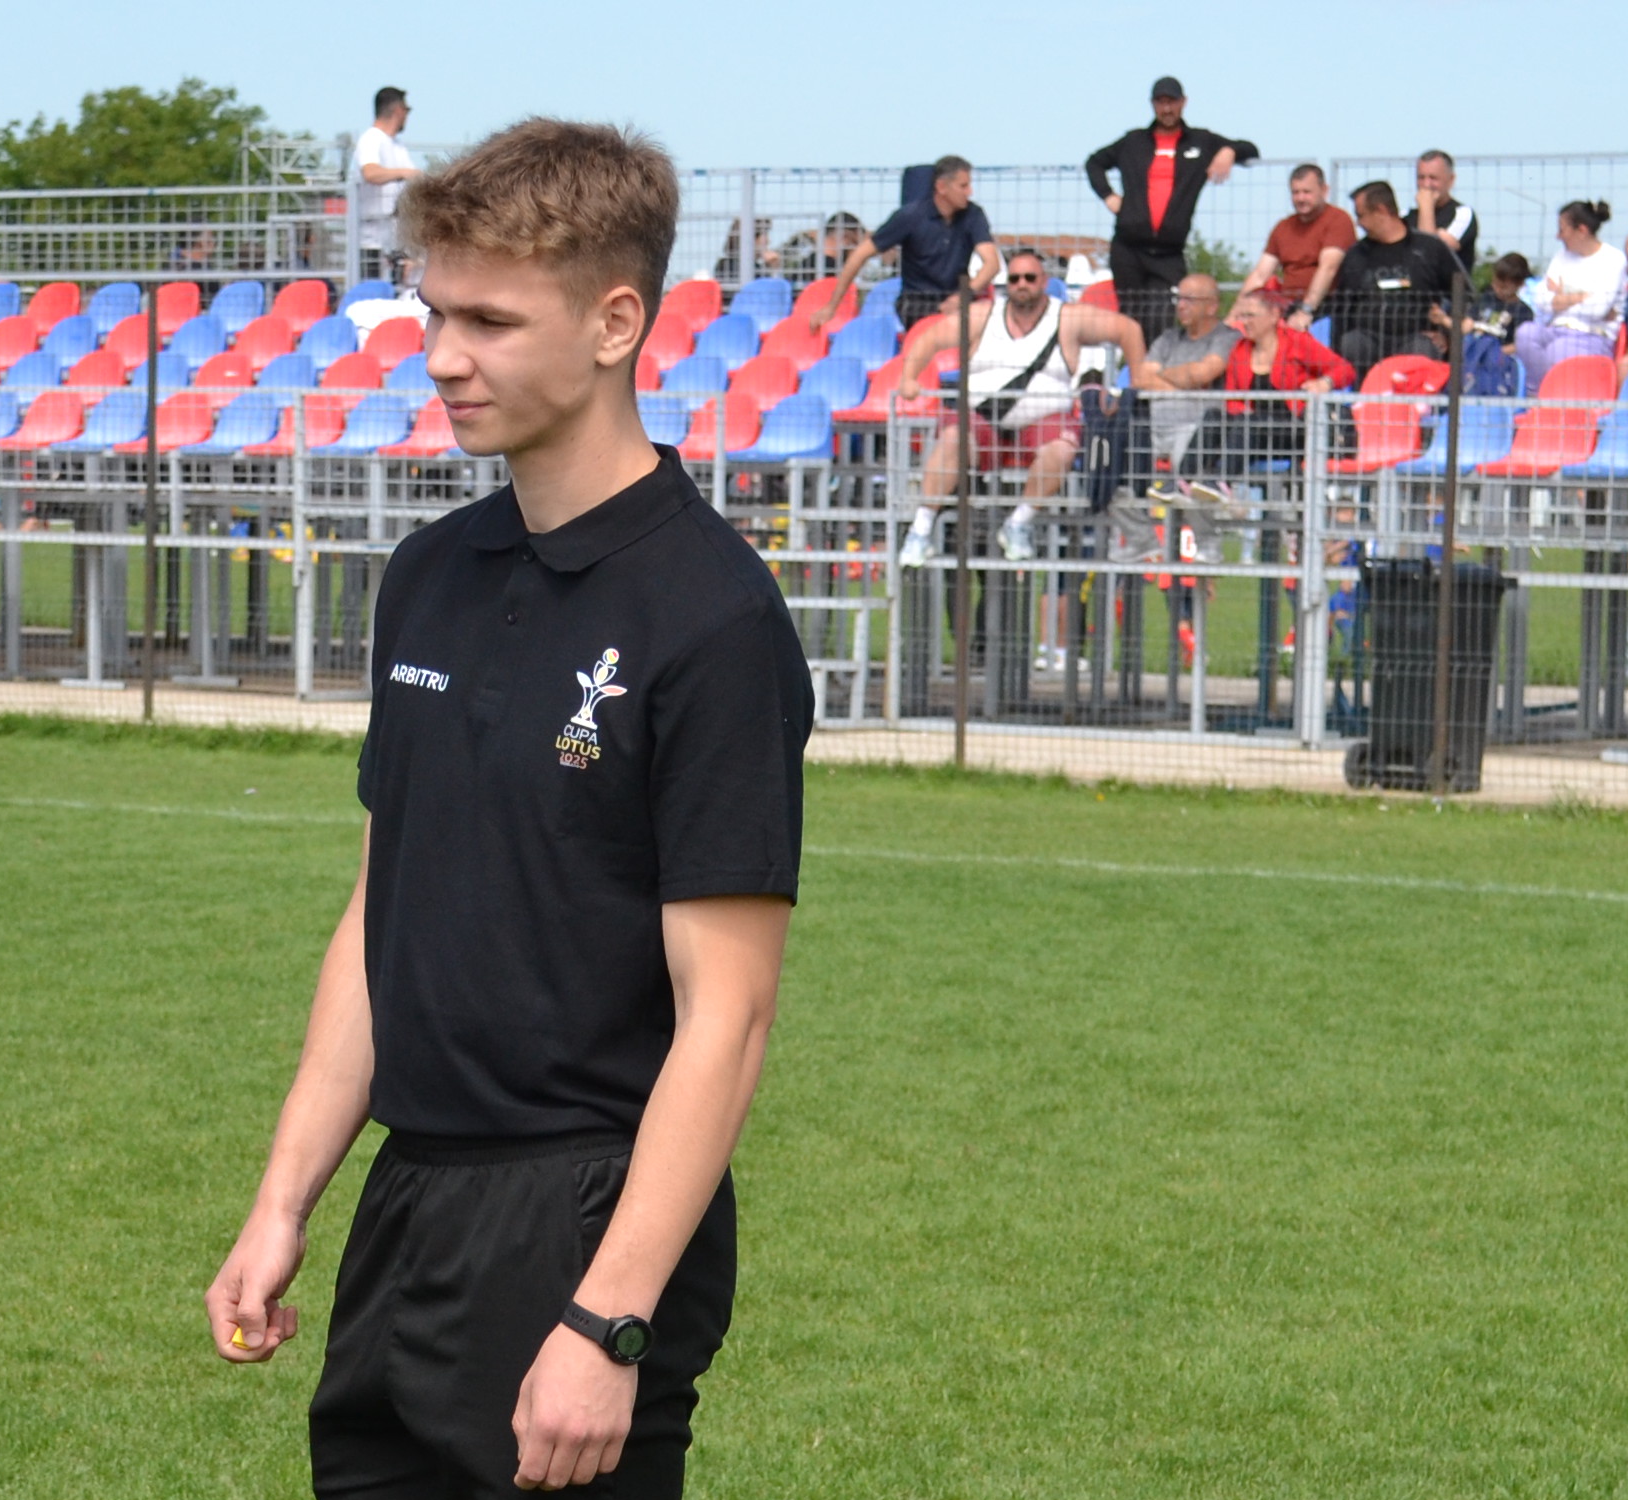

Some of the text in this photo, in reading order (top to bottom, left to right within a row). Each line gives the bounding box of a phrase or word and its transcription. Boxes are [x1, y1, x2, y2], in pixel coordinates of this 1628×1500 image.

[389, 663, 450, 692] ARBITRU
[563, 724, 598, 746] CUPA
[555, 735, 602, 760] LOTUS
[559, 751, 589, 770] 2025
